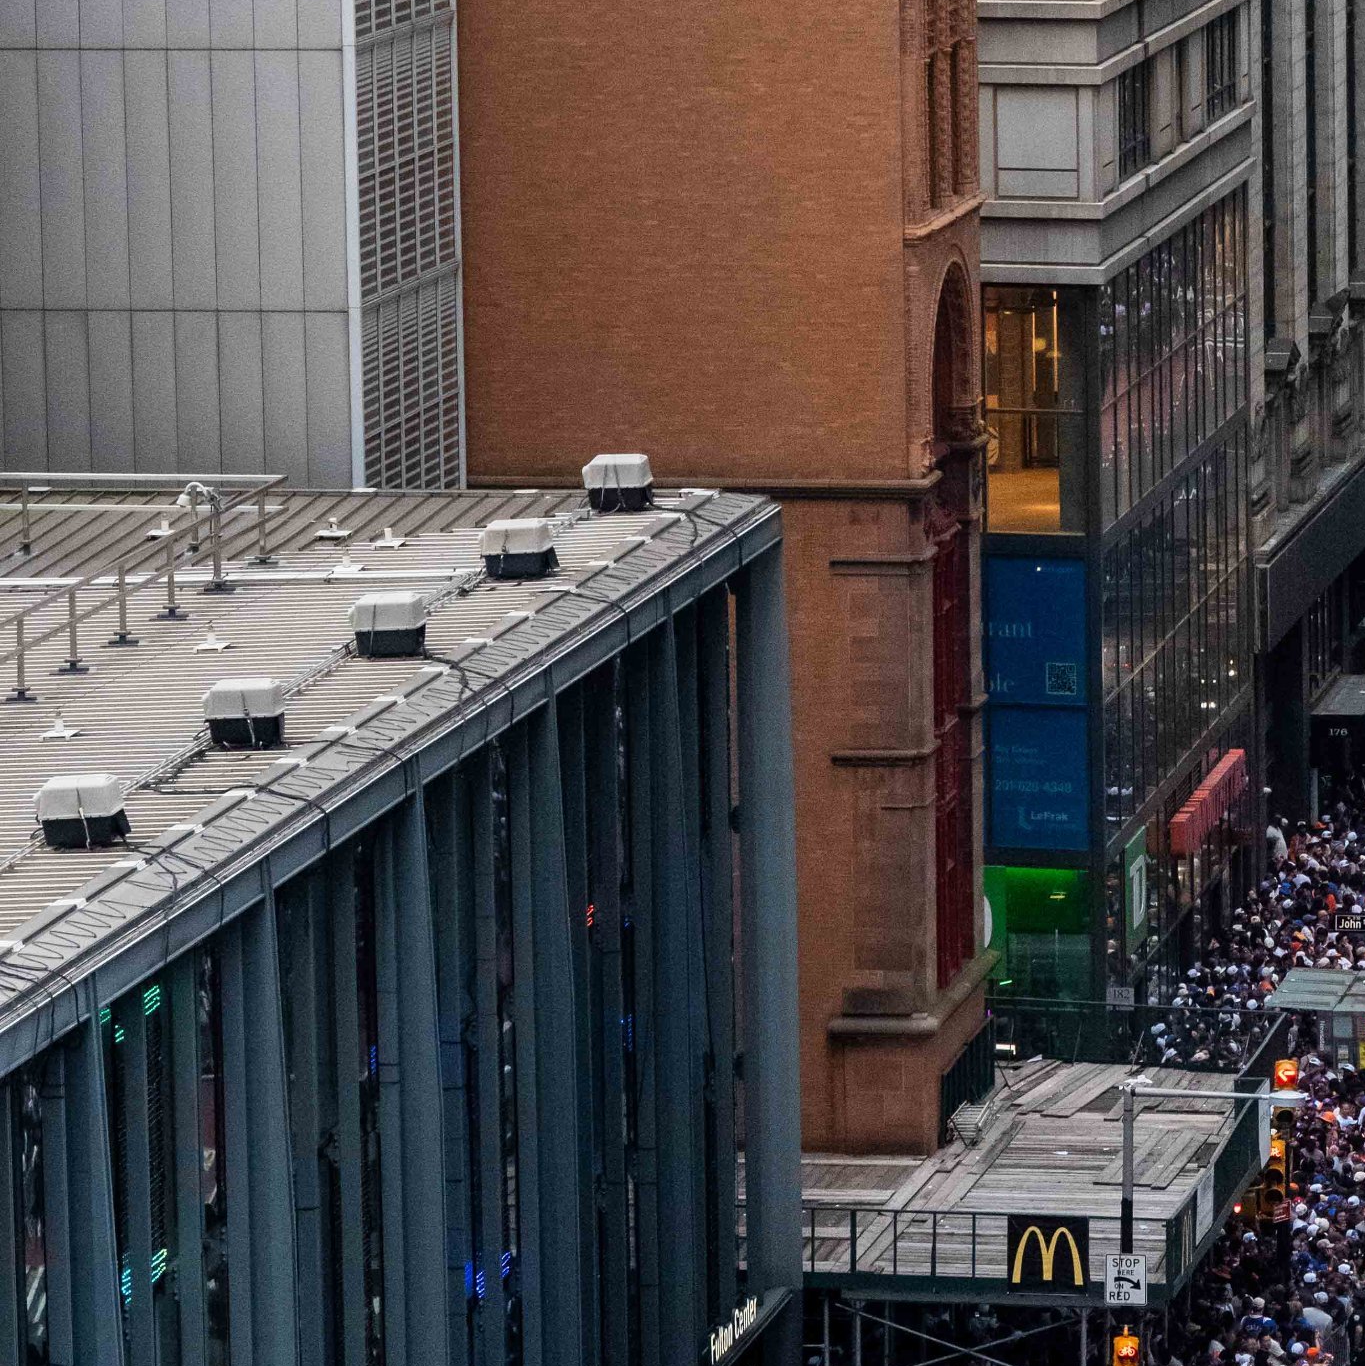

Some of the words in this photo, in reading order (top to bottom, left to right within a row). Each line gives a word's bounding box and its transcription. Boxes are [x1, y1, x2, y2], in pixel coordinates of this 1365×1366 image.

[1329, 728, 1348, 736] 176
[1339, 919, 1362, 929] John
[1113, 989, 1130, 1000] 182
[1112, 1258, 1140, 1268] STOP
[1109, 1291, 1131, 1301] RED
[710, 1323, 733, 1365] Fulton
[734, 1297, 757, 1340] Center
